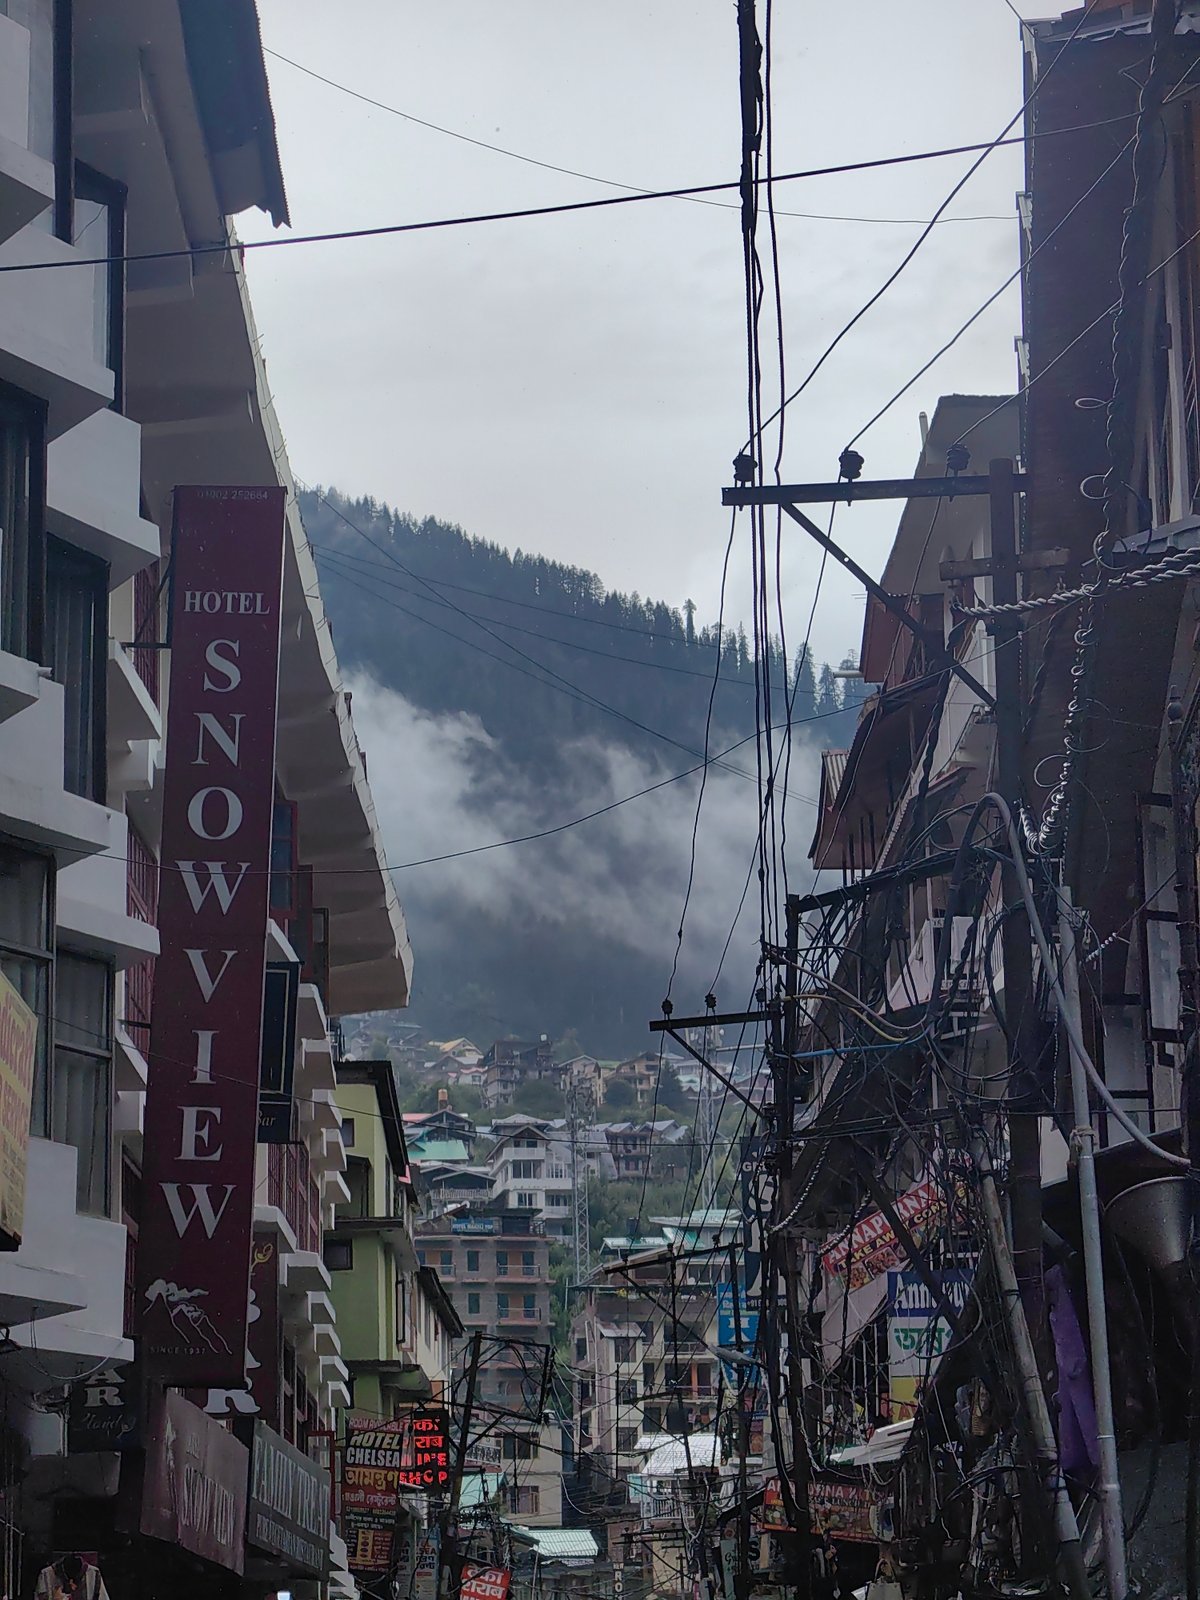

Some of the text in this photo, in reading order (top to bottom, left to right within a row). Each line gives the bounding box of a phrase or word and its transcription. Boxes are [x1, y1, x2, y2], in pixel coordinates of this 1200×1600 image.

[183, 590, 270, 616] HOTEL
[174, 638, 252, 916] SNOW
[158, 947, 238, 1239] VIEW
[346, 1447, 400, 1468] CHELSEA
[350, 1430, 401, 1450] HOTEL
[297, 1465, 330, 1541] TREAT
